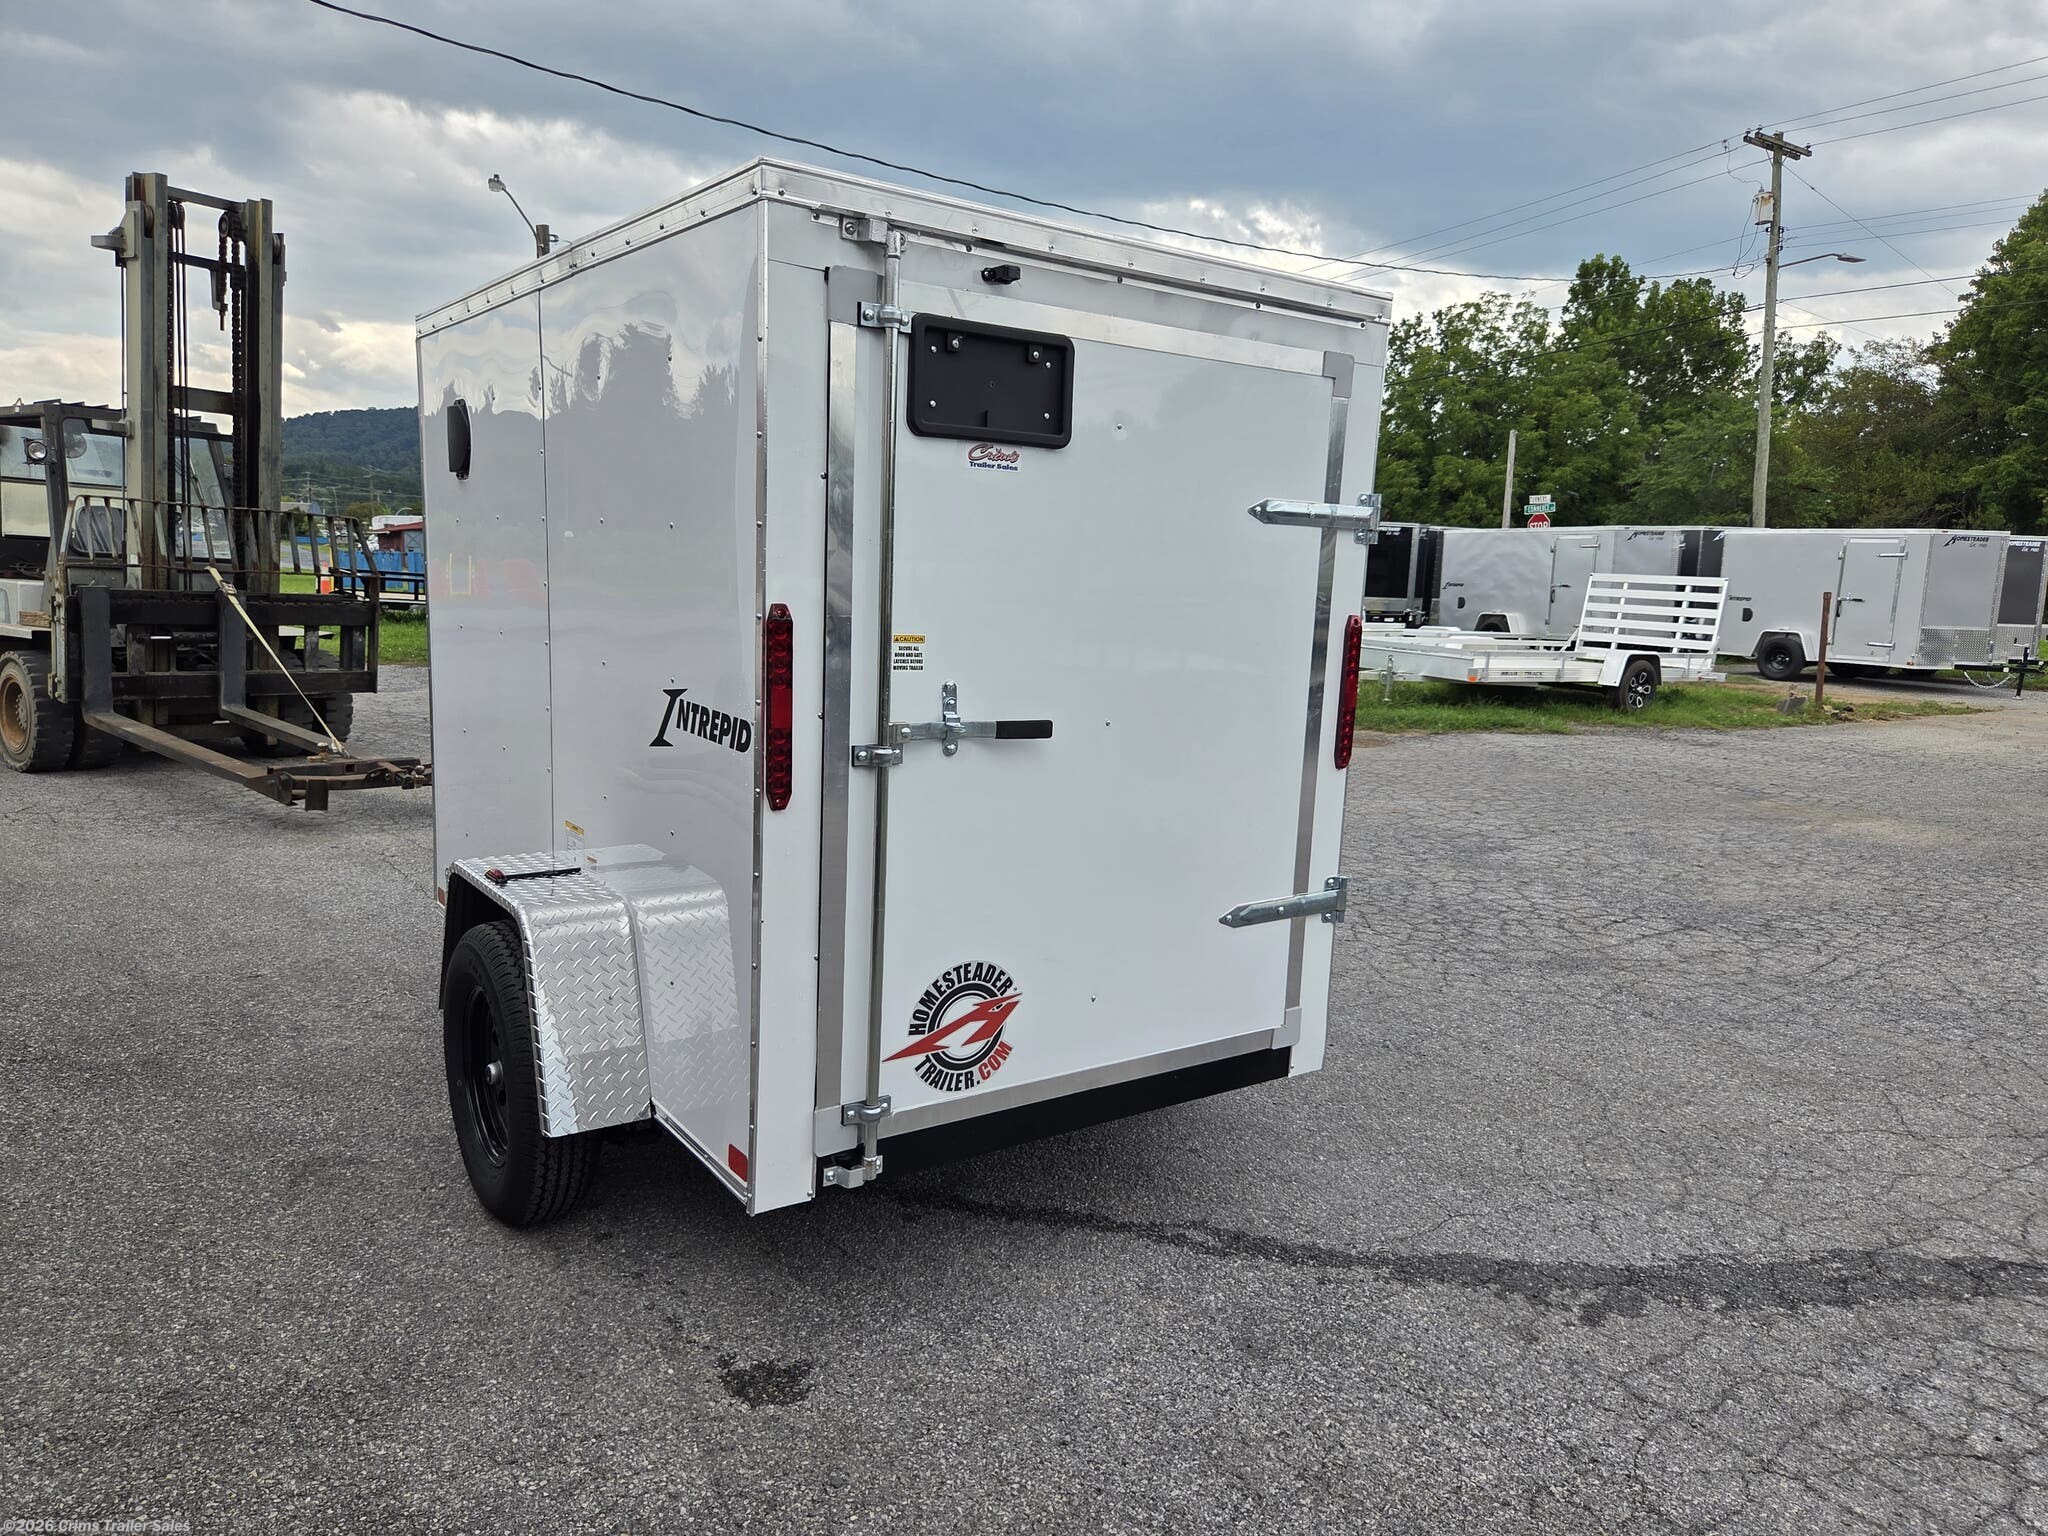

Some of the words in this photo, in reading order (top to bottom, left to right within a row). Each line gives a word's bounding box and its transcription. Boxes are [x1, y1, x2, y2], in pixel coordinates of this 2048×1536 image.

[969, 461, 996, 469] Trailer
[997, 463, 1018, 471] Sales
[649, 688, 752, 753] INTREPID
[908, 962, 1014, 1036] HOMESTEADER
